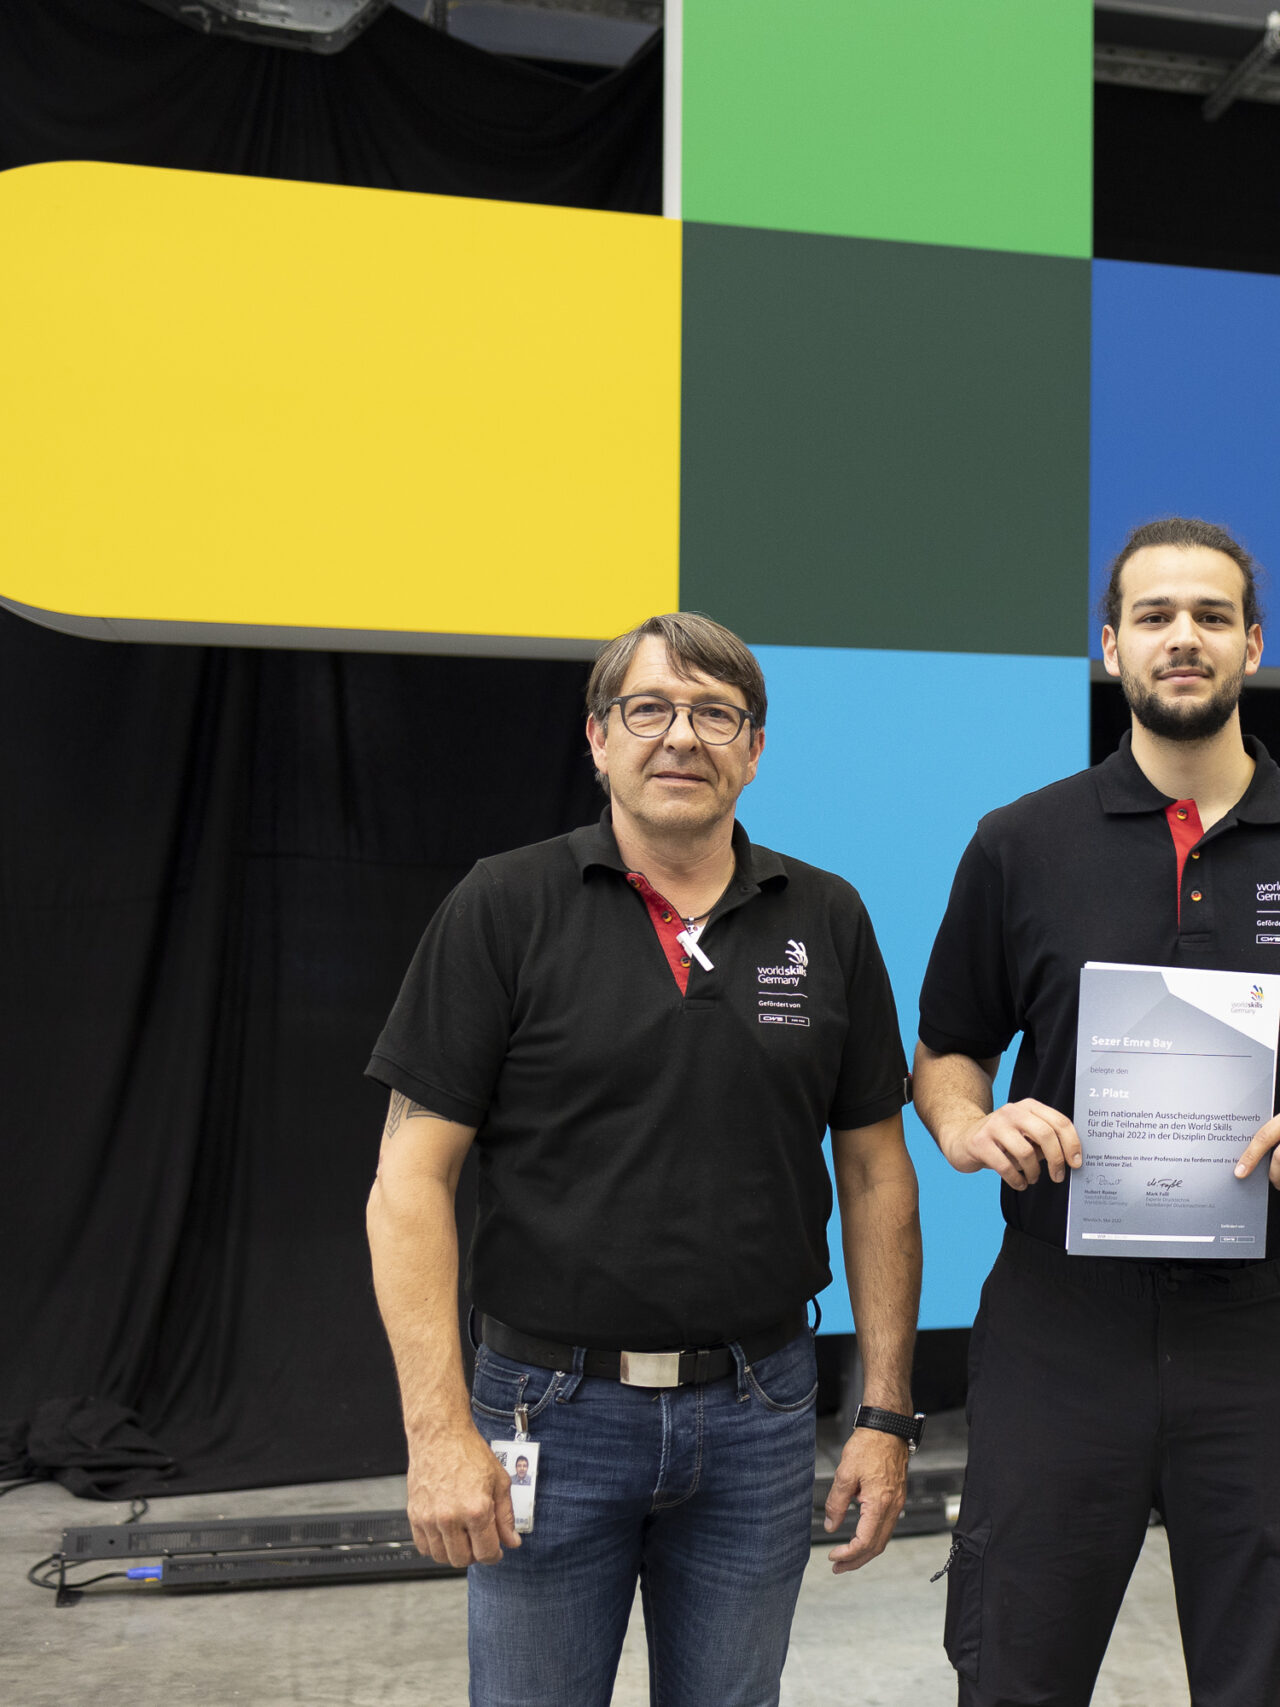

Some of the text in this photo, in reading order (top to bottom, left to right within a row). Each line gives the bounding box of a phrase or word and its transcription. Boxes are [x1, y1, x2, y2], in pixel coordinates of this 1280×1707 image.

[758, 965, 806, 976] worldskills
[758, 974, 799, 986] Germany
[1091, 1036, 1173, 1050] Sezer Emre Bay
[1090, 1066, 1114, 1075] belegte
[1089, 1088, 1130, 1098] 2. Platz
[1088, 1109, 1260, 1122] beim nationalen Ausscheidungswettbewerb
[1088, 1119, 1100, 1127] für
[1102, 1120, 1114, 1128] die
[1116, 1120, 1157, 1130] Teilnahme
[1171, 1122, 1186, 1130] den
[1188, 1122, 1212, 1131] World
[1213, 1123, 1232, 1131] Skills
[1088, 1130, 1125, 1140] Shanghai
[1127, 1132, 1146, 1140] 2022
[1158, 1132, 1171, 1140] der
[1172, 1133, 1206, 1142] Disziplin
